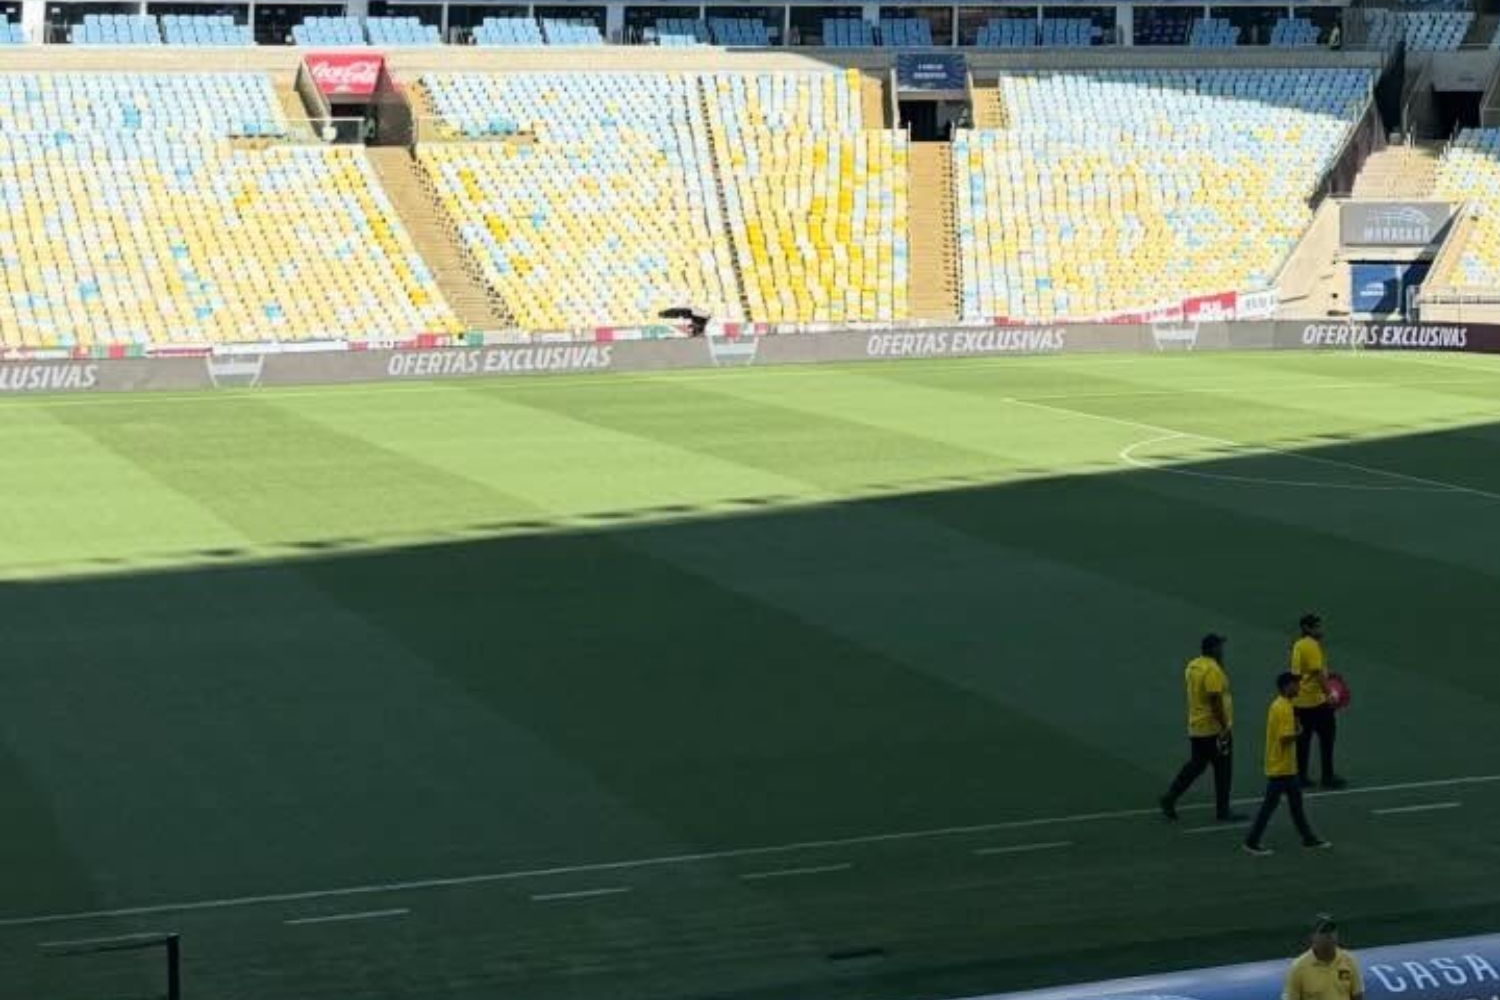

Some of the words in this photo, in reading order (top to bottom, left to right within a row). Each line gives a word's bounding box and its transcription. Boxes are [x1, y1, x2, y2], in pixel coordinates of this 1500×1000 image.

[866, 333, 946, 355] OFERTAS
[951, 328, 1066, 351] EXCLUSIVAS
[1302, 324, 1377, 344] OFERTAS
[1379, 326, 1467, 347] EXCLUSIVAS
[388, 351, 478, 375] OFERTAS
[483, 345, 612, 371] EXCLUSIVAS
[1370, 955, 1499, 993] CASA
